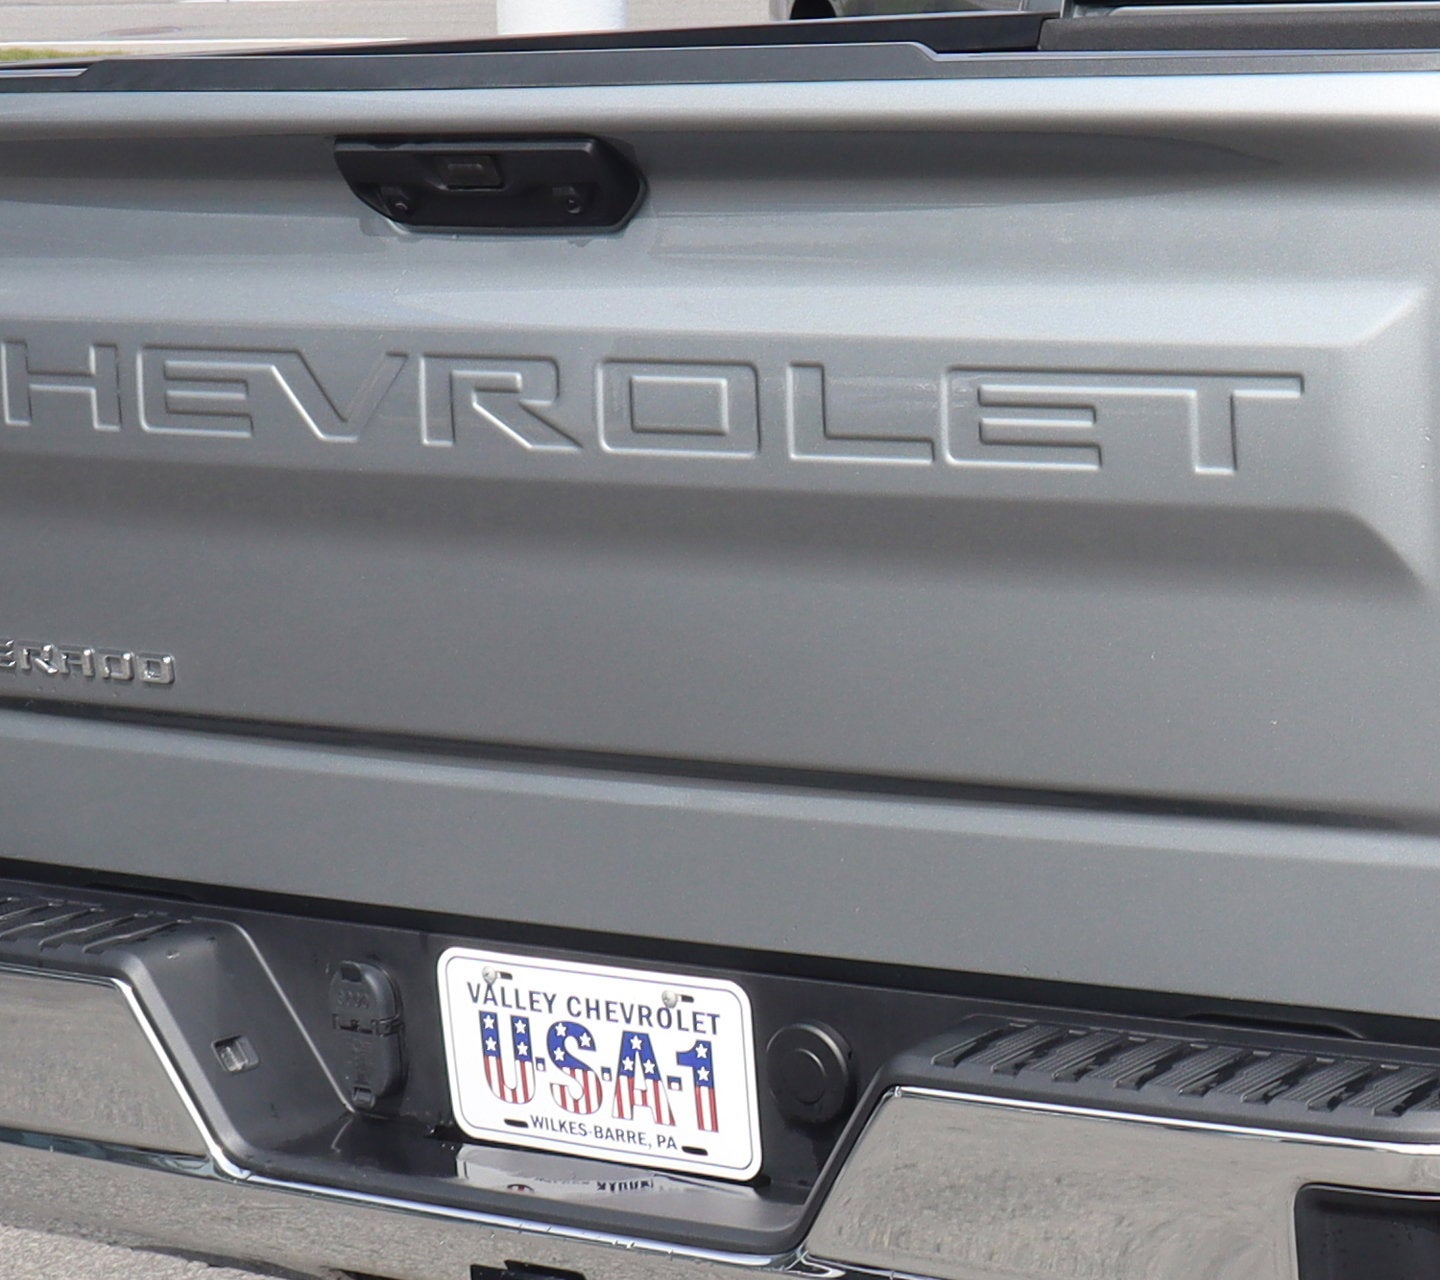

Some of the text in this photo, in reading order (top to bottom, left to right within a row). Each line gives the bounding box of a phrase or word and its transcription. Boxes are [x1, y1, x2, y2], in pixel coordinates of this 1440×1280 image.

[466, 981, 721, 1036] VALLEY CHEVROLET
[529, 1114, 679, 1151] WILKES-BARRE, PA
